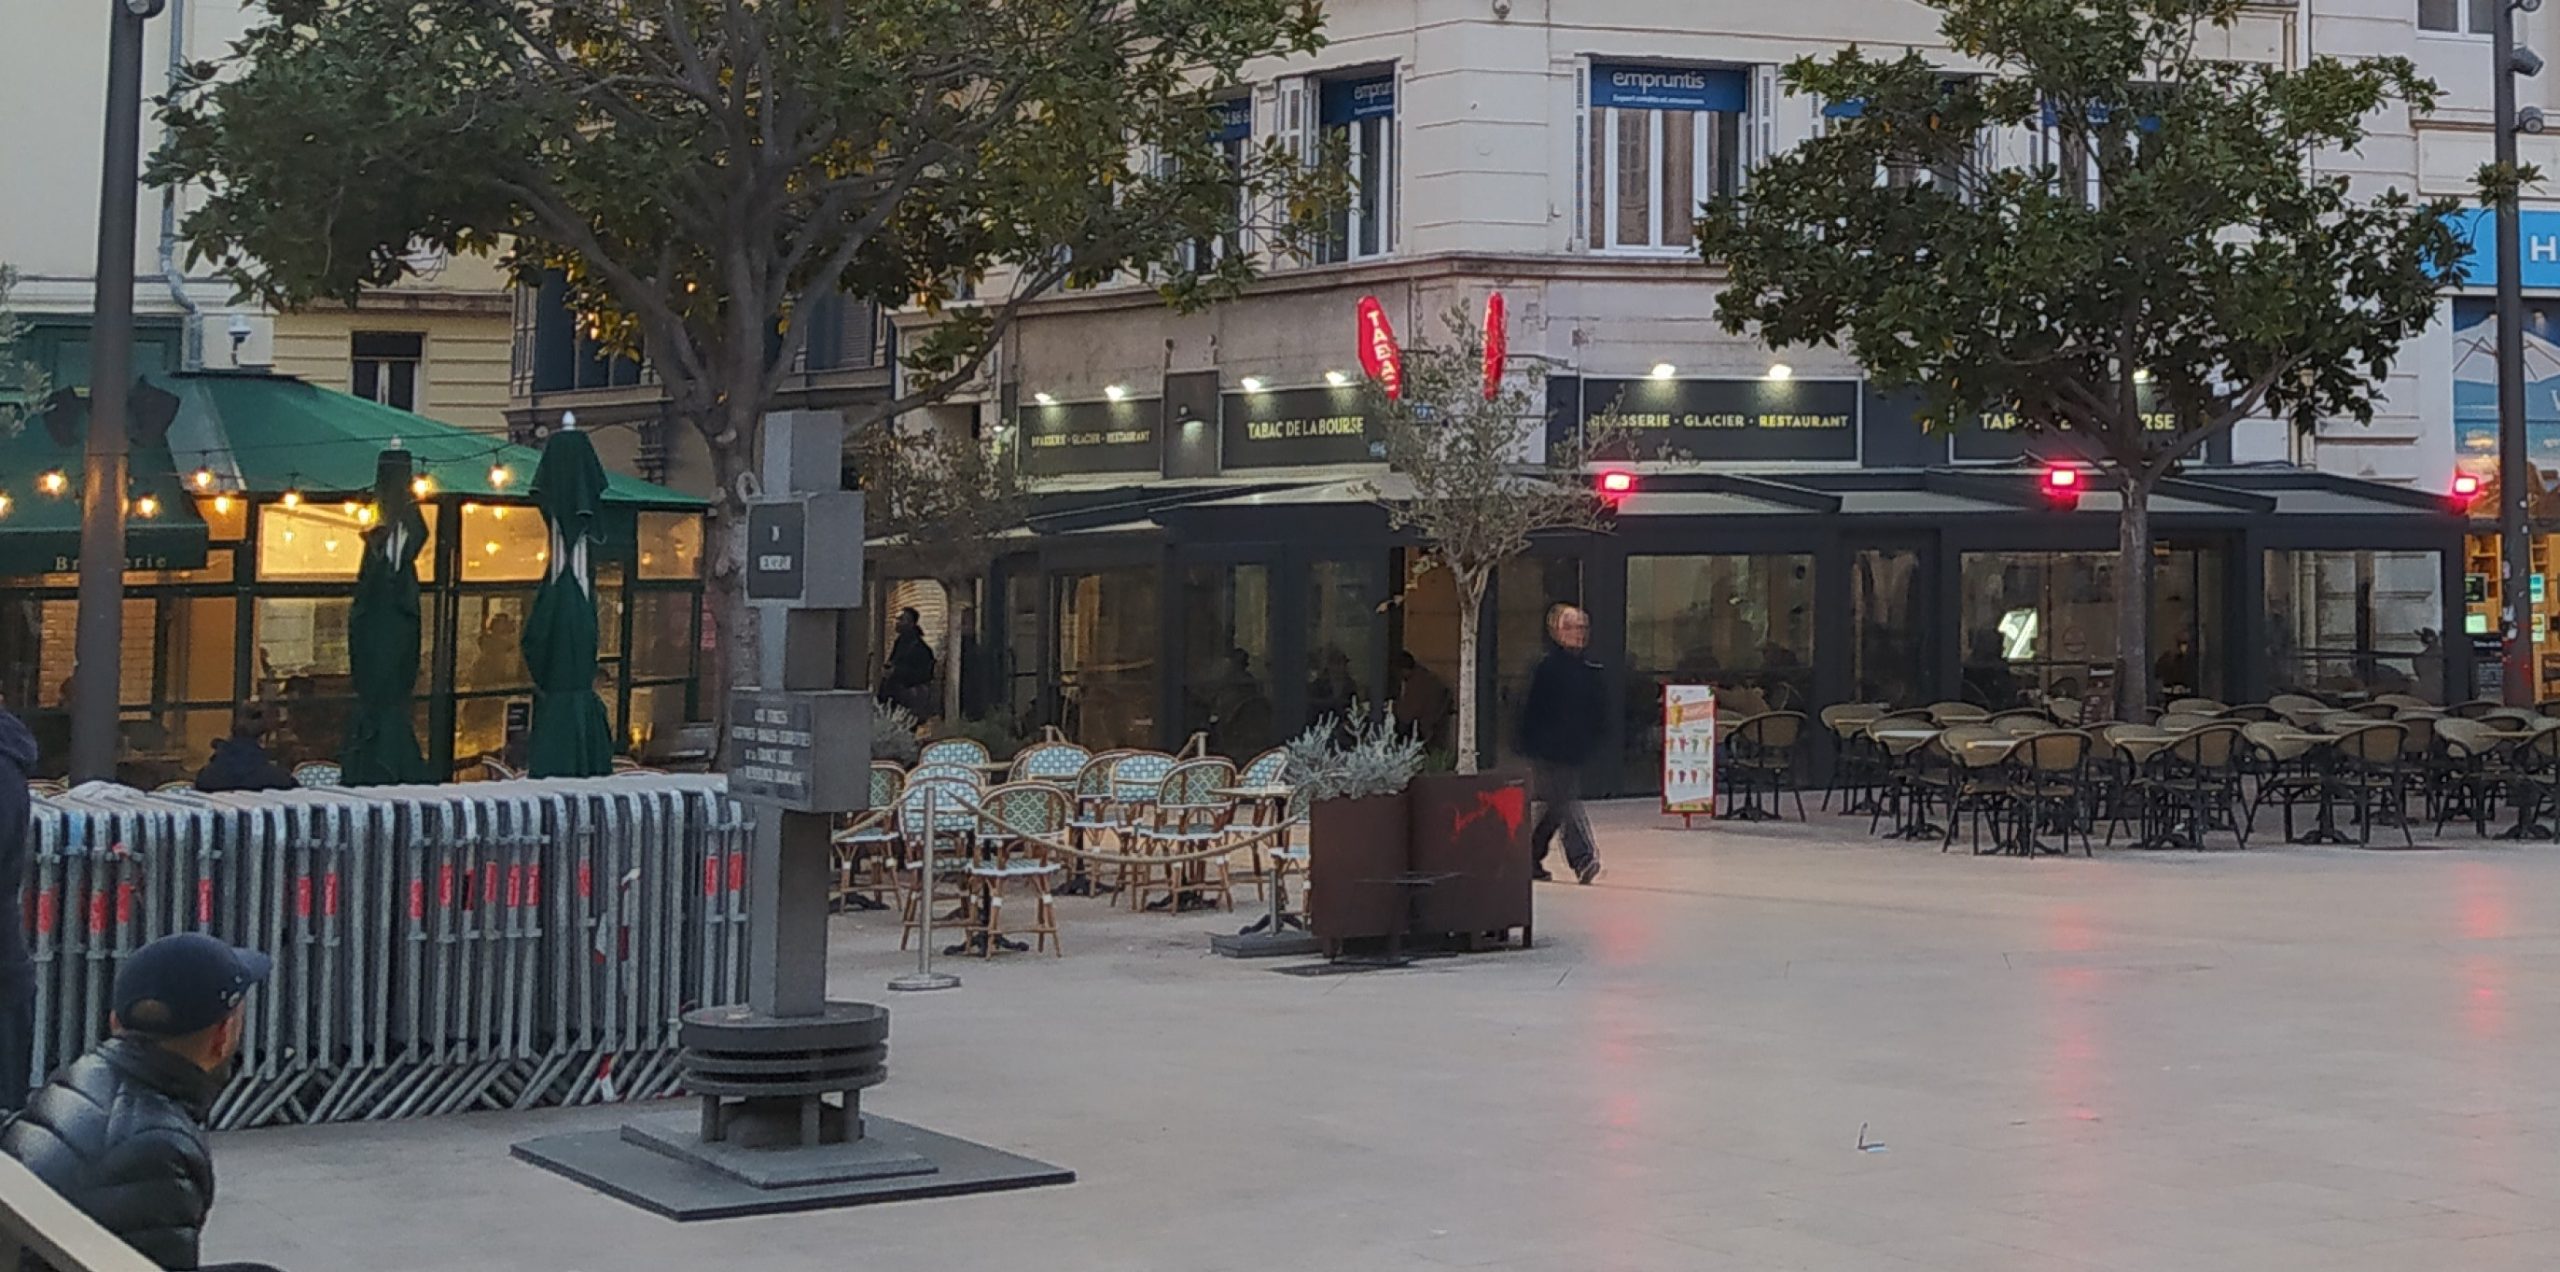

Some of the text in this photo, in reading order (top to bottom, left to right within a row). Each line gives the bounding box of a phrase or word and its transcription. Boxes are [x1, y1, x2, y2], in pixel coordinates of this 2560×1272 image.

[1612, 71, 1705, 95] empruntis
[1247, 416, 1364, 439] TABAC DE LA BOURSE
[1590, 413, 1849, 428] SSERIE GLACIER RESTAURANT
[55, 553, 168, 571] Brerie
